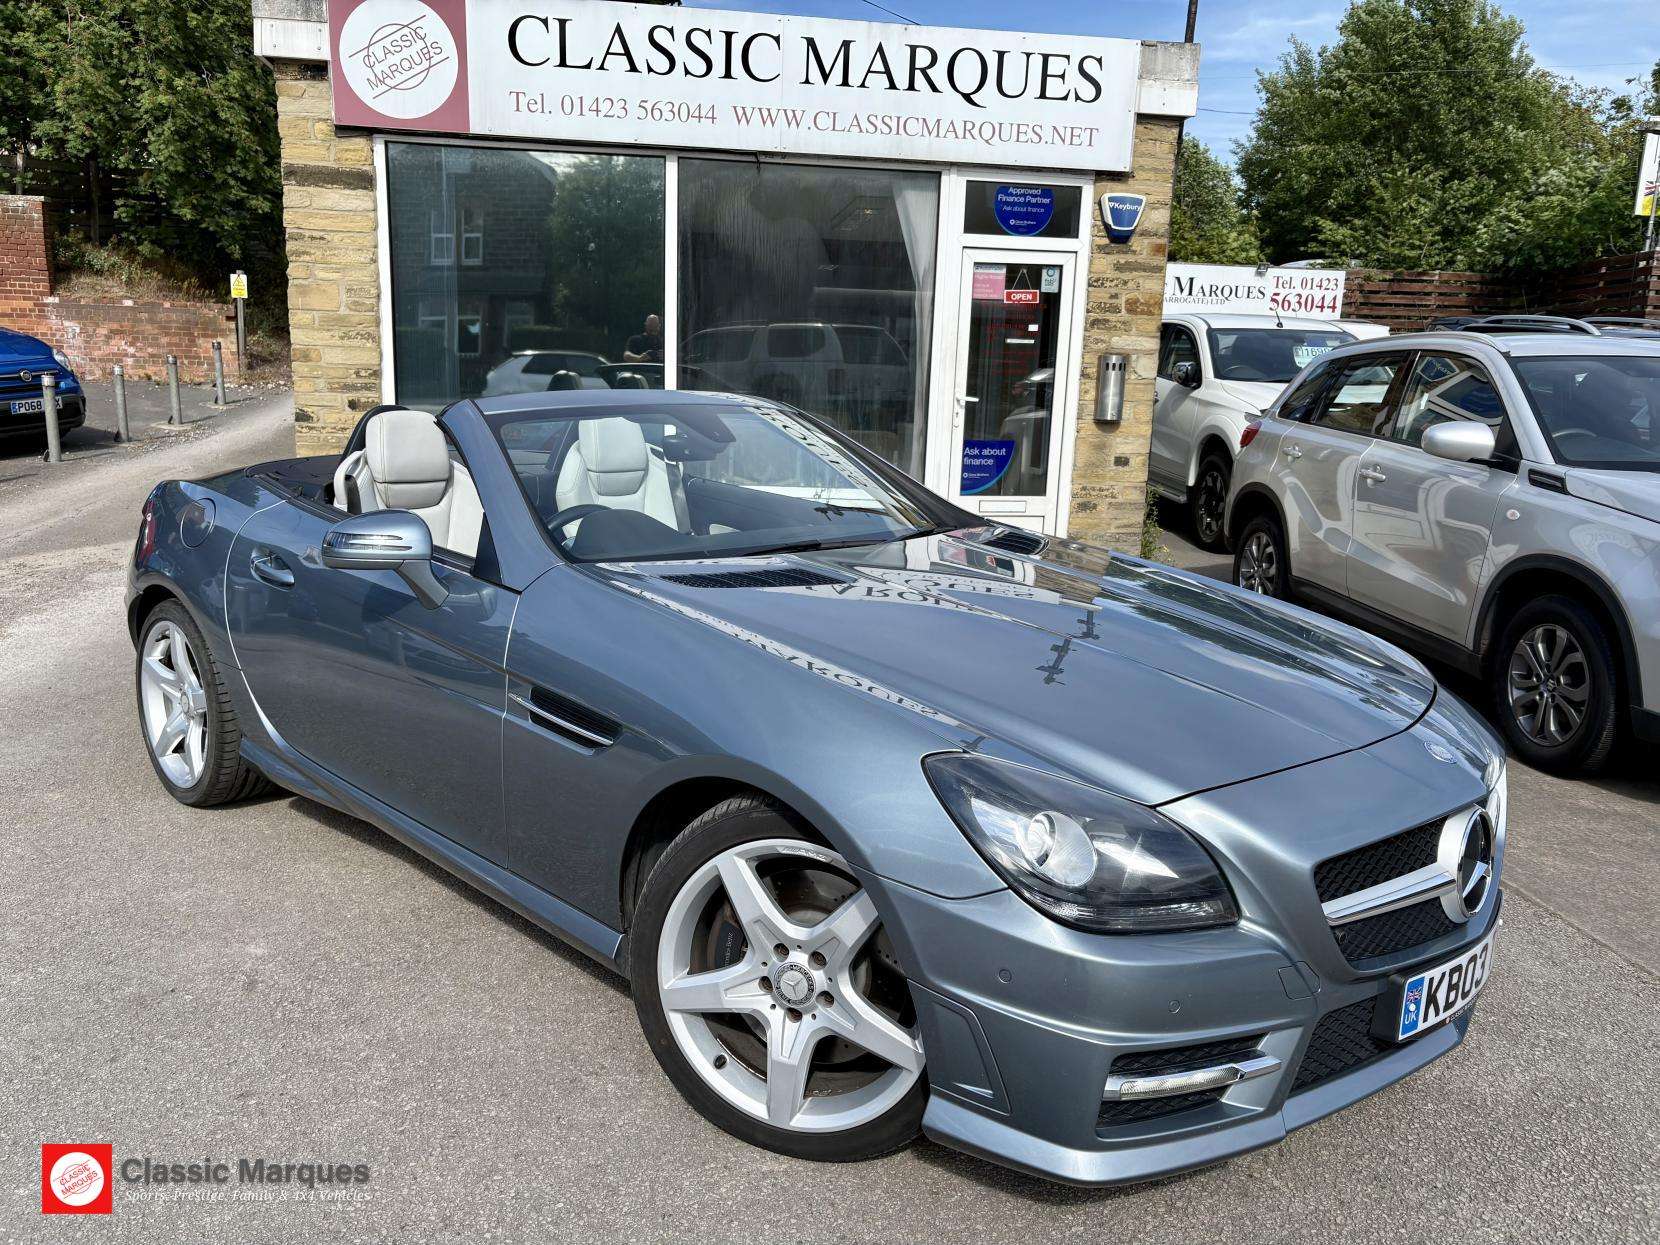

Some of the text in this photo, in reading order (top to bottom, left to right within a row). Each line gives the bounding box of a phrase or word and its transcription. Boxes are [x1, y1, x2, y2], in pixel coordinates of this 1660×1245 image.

[362, 26, 427, 68] CLASSIC
[366, 41, 443, 91] MARQUES
[507, 14, 1104, 108] CLASSIC MARQUES
[509, 91, 552, 114] Tel.
[561, 94, 628, 119] 01423
[637, 99, 718, 125] 563044
[998, 193, 1051, 204] Finance Partner
[1008, 186, 1041, 195] Approved
[1114, 201, 1140, 211] Keybury
[1273, 275, 1339, 291] Tel. 01423
[1269, 292, 1338, 313] 563044
[964, 447, 1007, 456] Ask about
[963, 457, 994, 466] finance
[1404, 1009, 1417, 1025] UK
